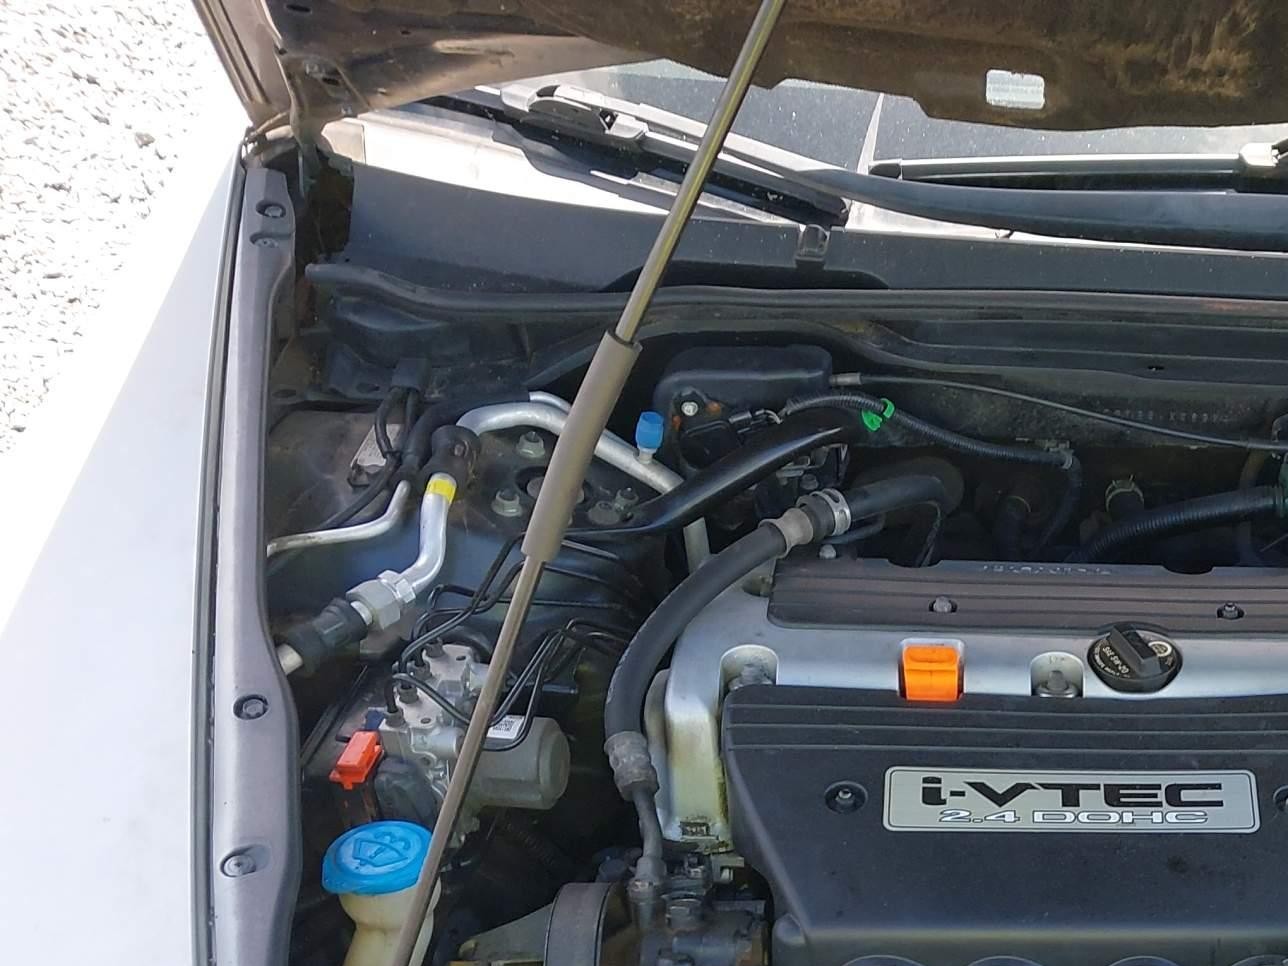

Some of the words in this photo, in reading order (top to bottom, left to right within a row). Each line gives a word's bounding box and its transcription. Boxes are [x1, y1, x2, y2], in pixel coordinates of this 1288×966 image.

[921, 775, 1224, 808] i-VTEC
[938, 808, 1021, 825] 2.4
[1032, 809, 1209, 826] DOHC
